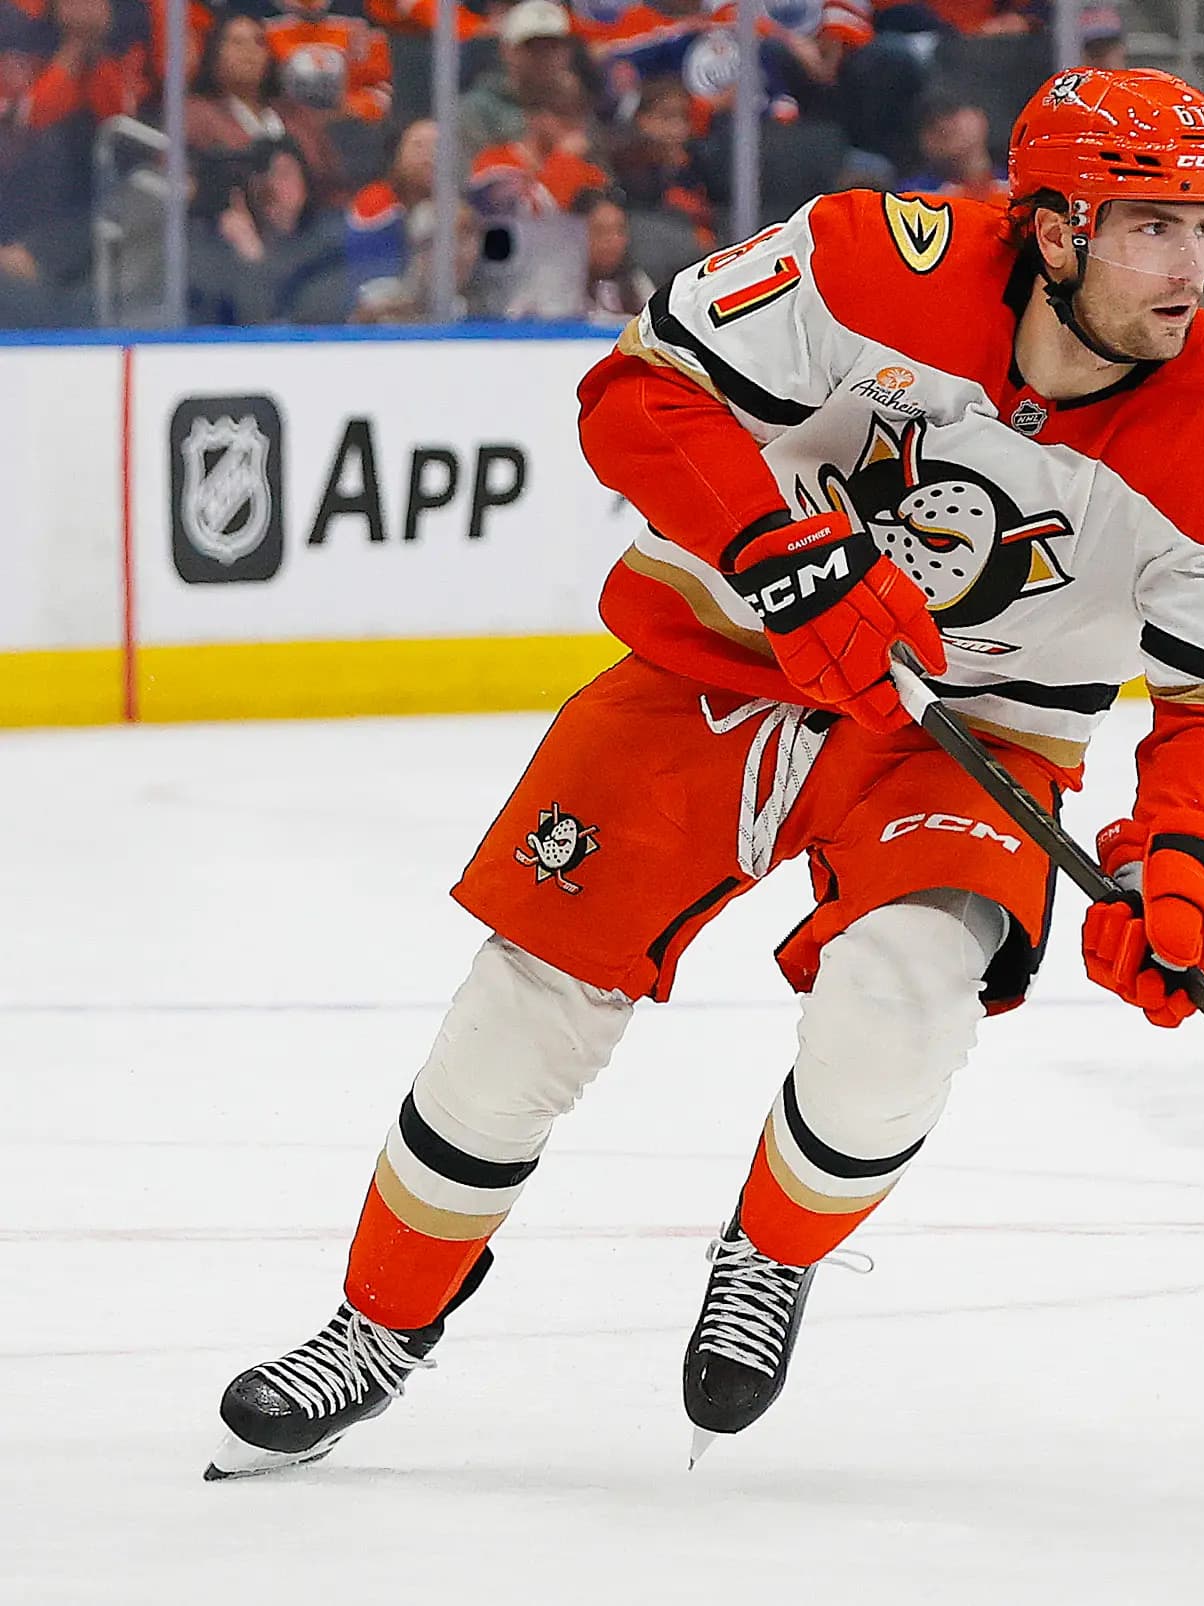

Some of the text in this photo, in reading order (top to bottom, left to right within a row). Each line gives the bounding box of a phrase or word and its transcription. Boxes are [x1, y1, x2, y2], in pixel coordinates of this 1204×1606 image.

[850, 379, 927, 417] Anaheim
[787, 526, 832, 551] GAUTHIER
[880, 812, 1022, 854] CCM
[1098, 824, 1121, 845] CM
